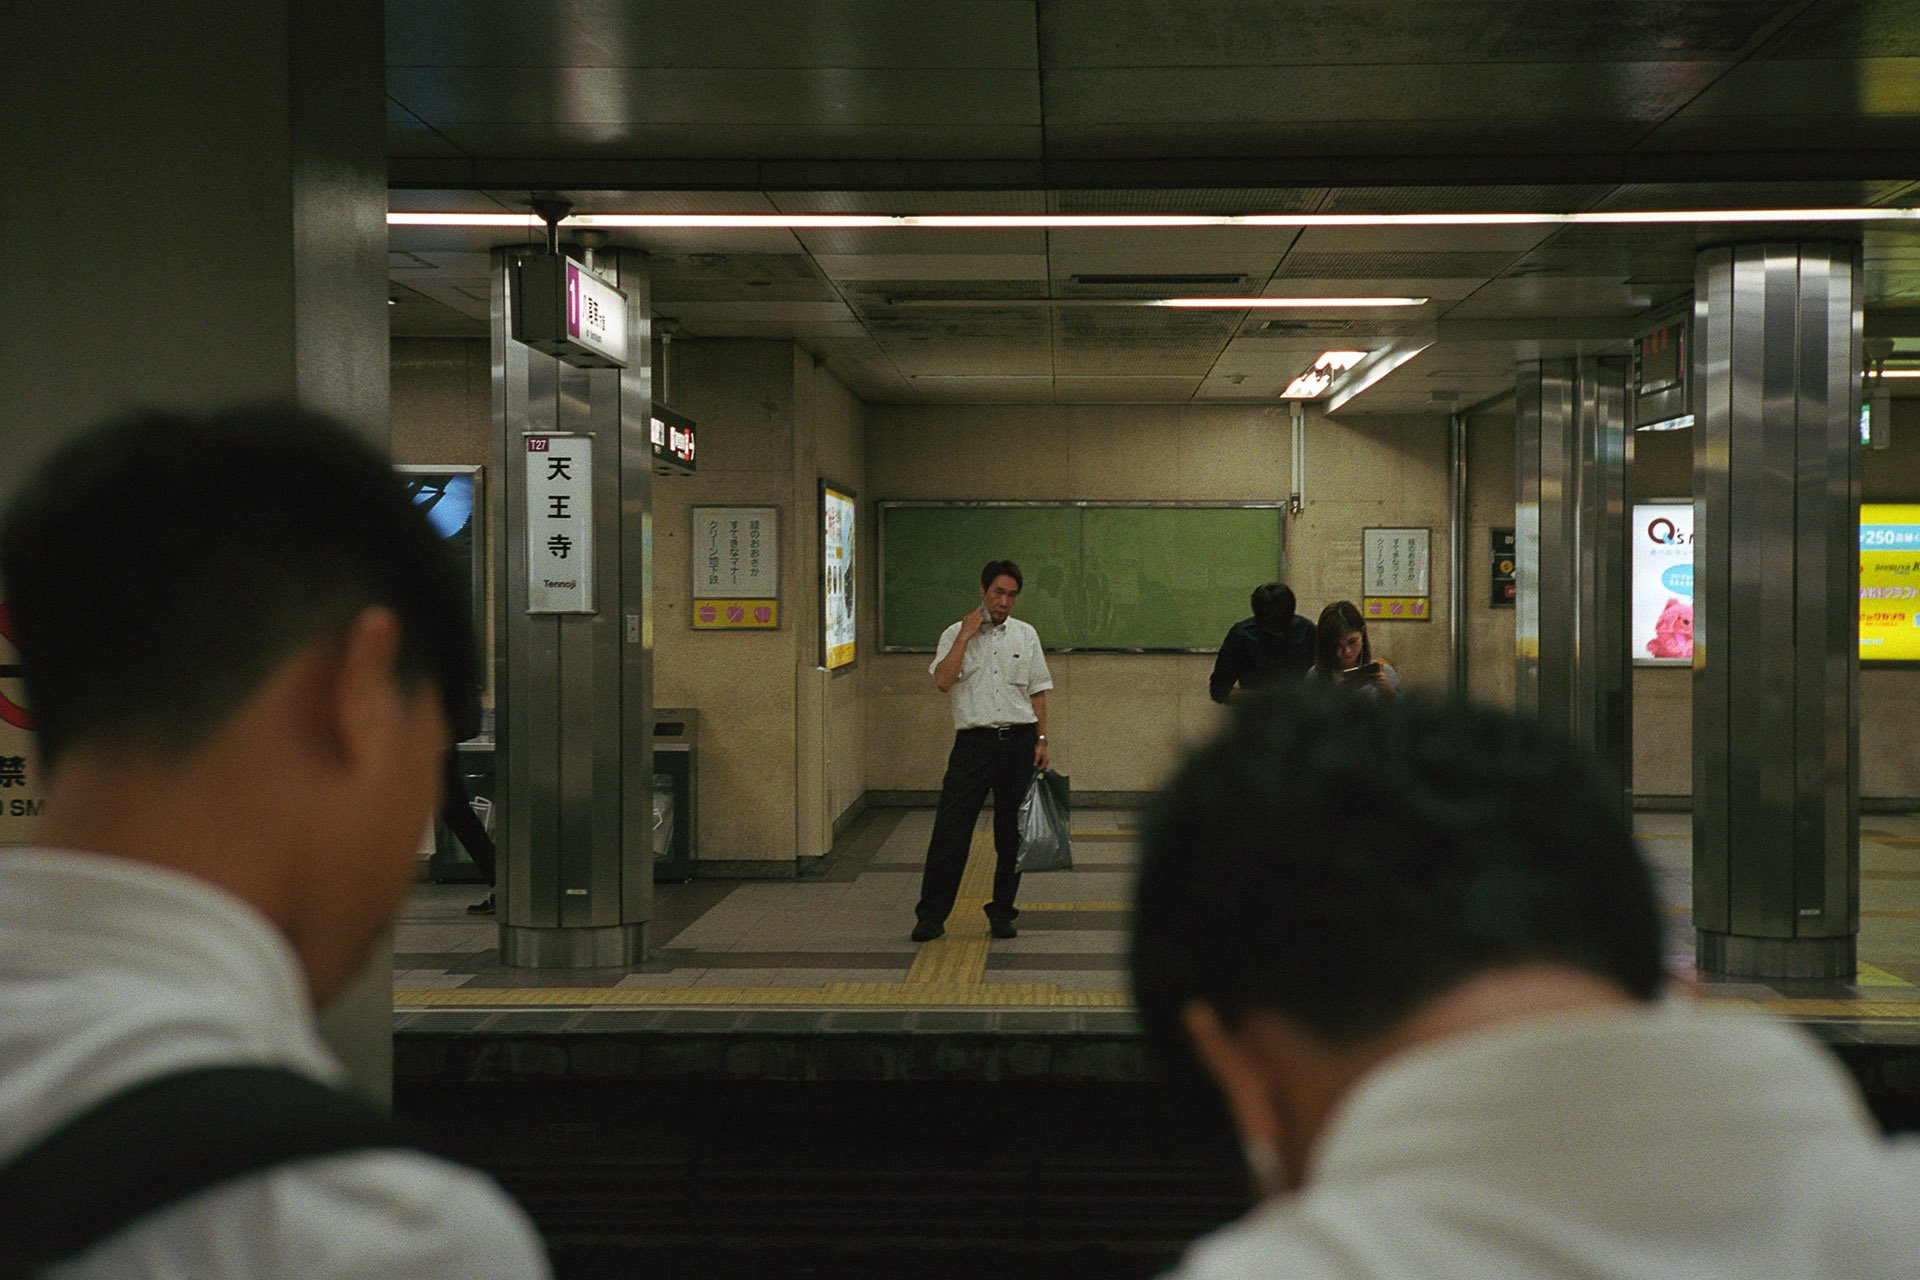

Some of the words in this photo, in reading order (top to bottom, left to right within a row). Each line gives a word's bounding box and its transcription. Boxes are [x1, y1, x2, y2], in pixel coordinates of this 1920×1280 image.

[568, 278, 577, 325] 1
[530, 439, 547, 451] T27
[547, 457, 572, 559] 天王寺
[1647, 517, 1685, 545] Q's
[708, 520, 720, 585] クリーン地下鉄
[729, 520, 739, 584] すてきなマナー
[749, 519, 761, 577] 緑のおおさか
[543, 579, 577, 590] Tennoji
[0, 755, 26, 787] 禁
